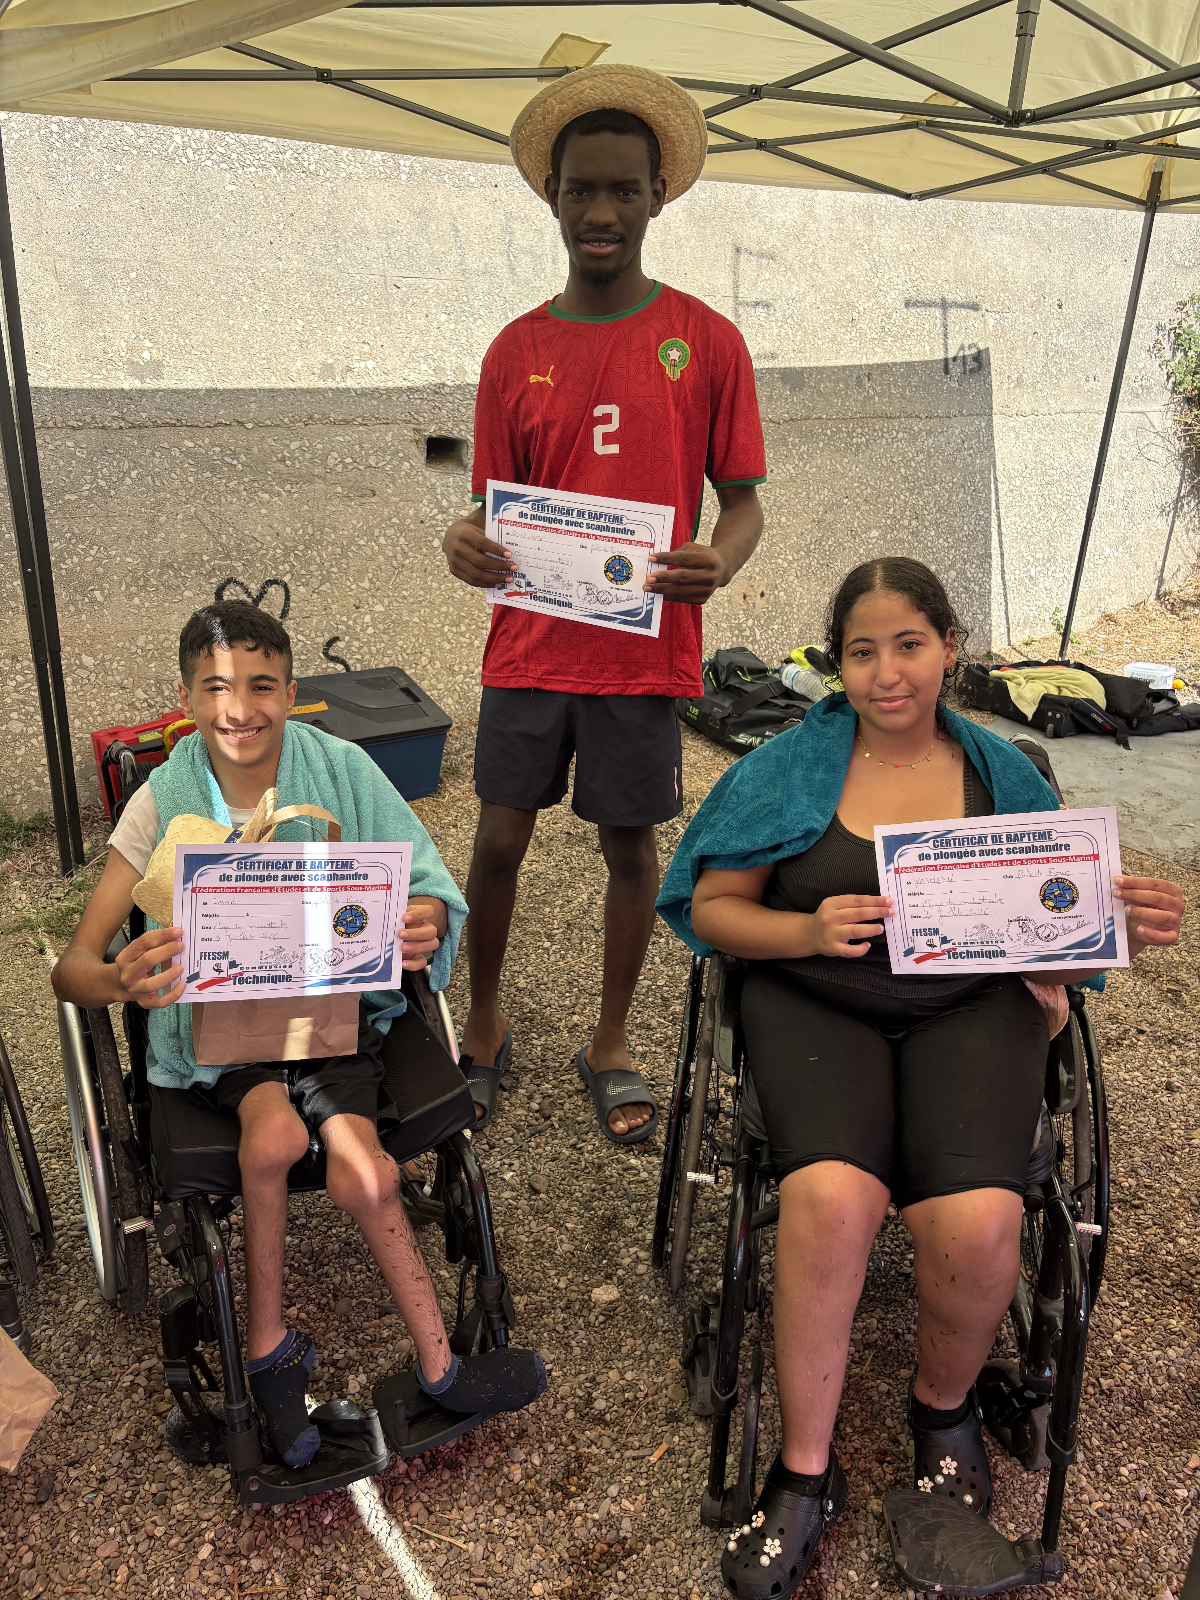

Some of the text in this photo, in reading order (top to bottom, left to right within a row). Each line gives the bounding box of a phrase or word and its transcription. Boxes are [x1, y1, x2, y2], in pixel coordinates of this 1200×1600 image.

[593, 404, 620, 455] 2
[531, 502, 575, 517] CERTIFICAT
[576, 509, 586, 519] DE
[518, 511, 636, 536] de plongée avec scaphandre
[529, 592, 573, 609] Technique
[932, 830, 1053, 849] CERTIFICAT DE BAPTEME
[918, 842, 1071, 861] de plongée avec scaphandre
[1049, 855, 1095, 863] Sous-Marins
[236, 860, 355, 871] CERTIFICAT DE BAPTEME
[218, 871, 369, 883] de plongée avec scaphandre
[322, 885, 346, 893] Sports
[911, 927, 940, 937] FFESSM
[200, 950, 230, 961] FFESSM
[946, 949, 1007, 960] Technique
[231, 974, 293, 986] Technique
